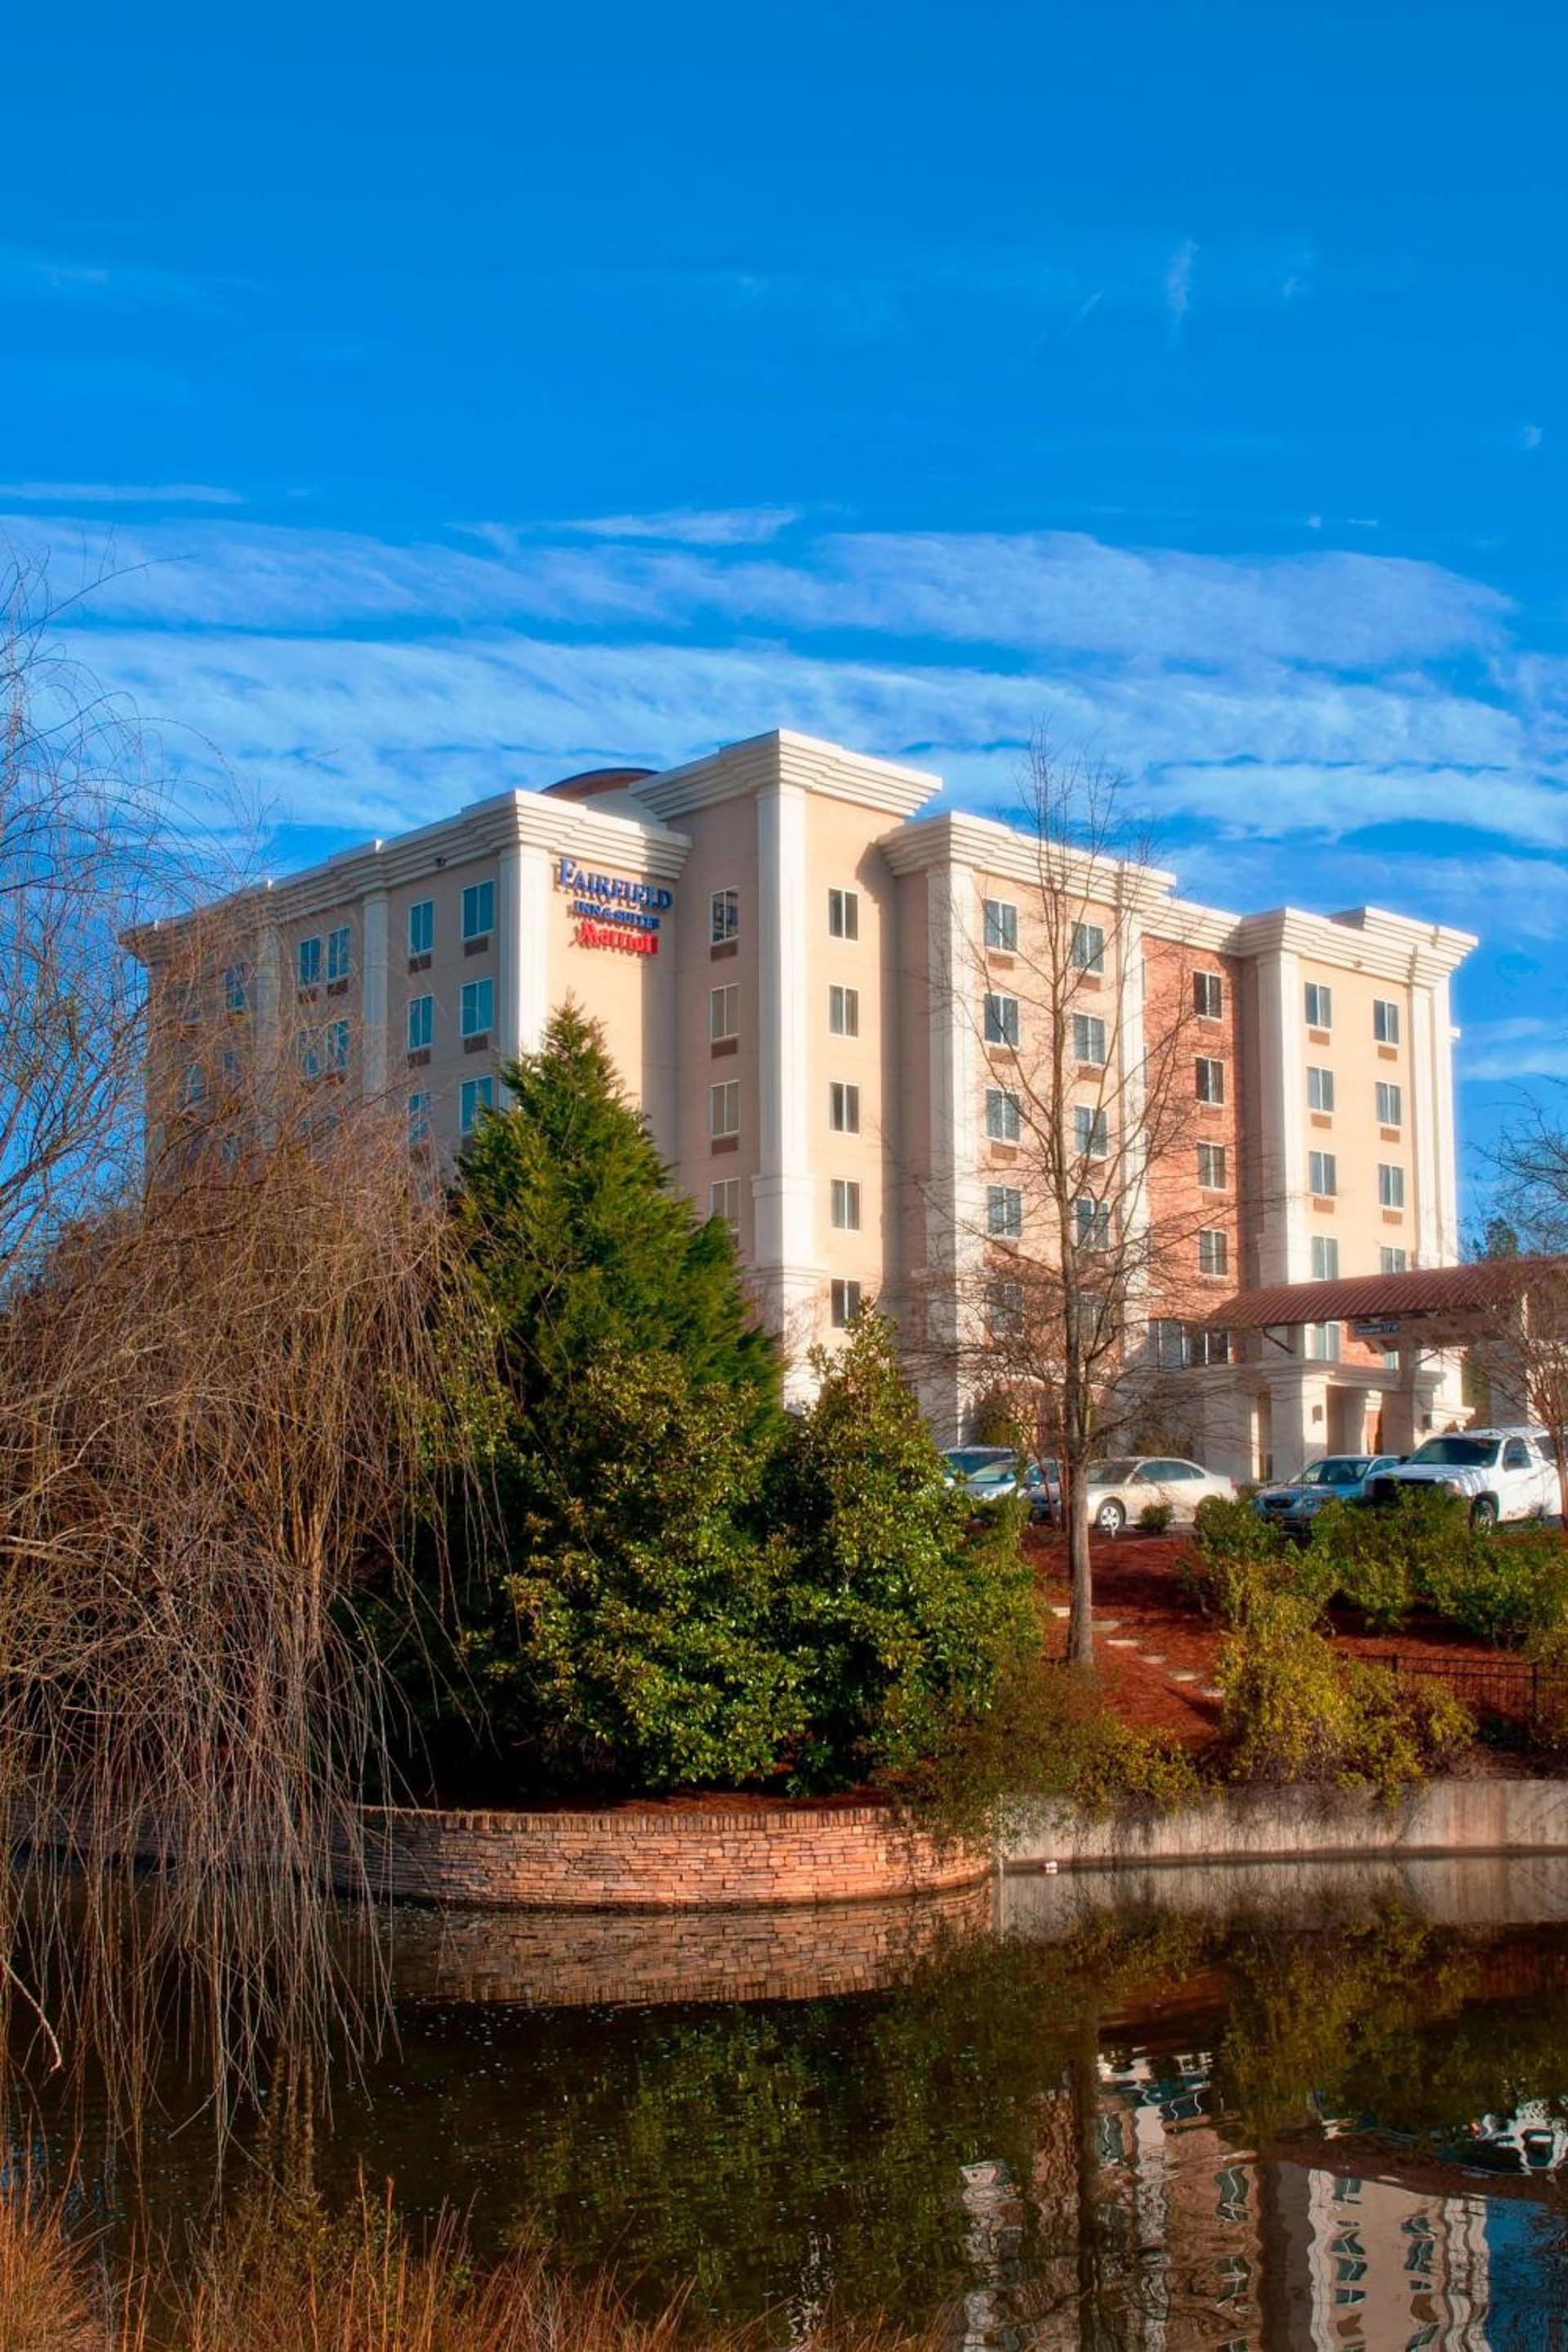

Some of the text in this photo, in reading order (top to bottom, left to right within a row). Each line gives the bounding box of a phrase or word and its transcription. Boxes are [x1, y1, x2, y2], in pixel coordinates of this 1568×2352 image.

[560, 858, 673, 910] FAIRFIELD
[575, 901, 601, 915] INN
[602, 907, 612, 920] &
